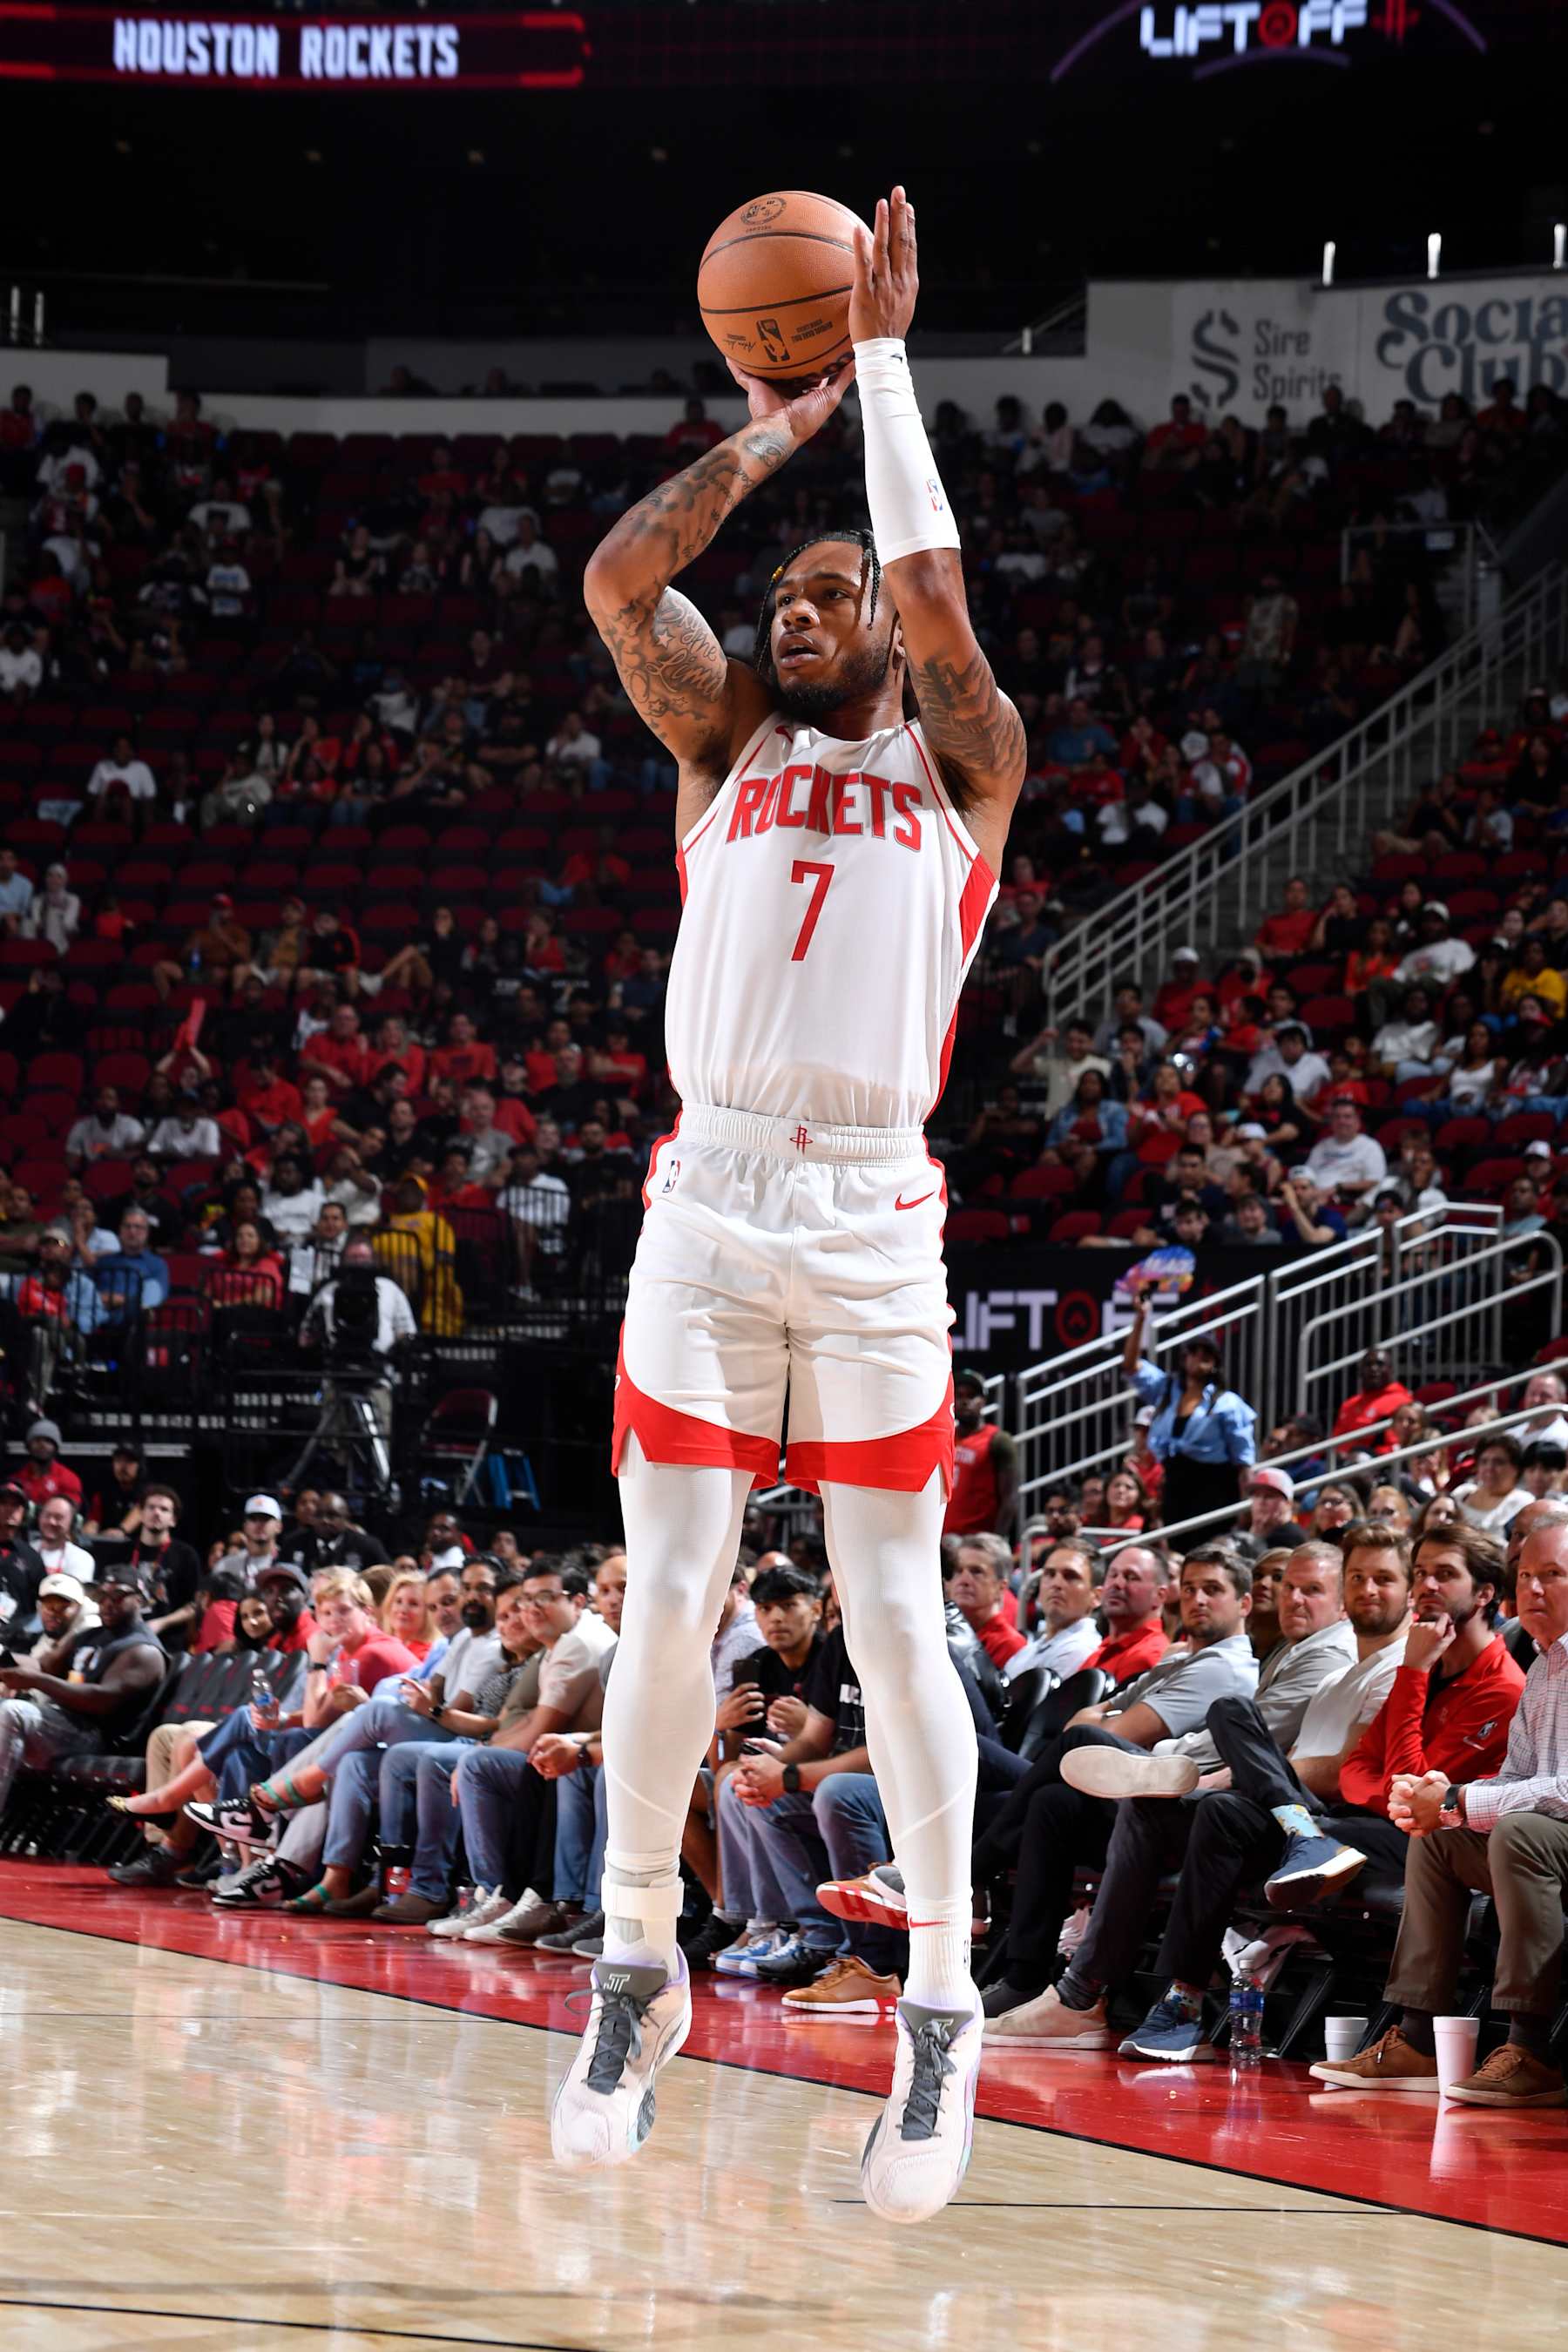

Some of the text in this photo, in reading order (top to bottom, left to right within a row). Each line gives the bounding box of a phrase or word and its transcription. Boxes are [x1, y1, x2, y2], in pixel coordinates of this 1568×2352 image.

[113, 18, 460, 79] HOUSTON ROCKETS
[1140, 0, 1367, 57] LIFTOFF
[1254, 319, 1310, 356] Sire
[725, 763, 923, 853] ROCKETS
[790, 859, 835, 962] 7
[953, 1289, 1180, 1351] IFTOFF
